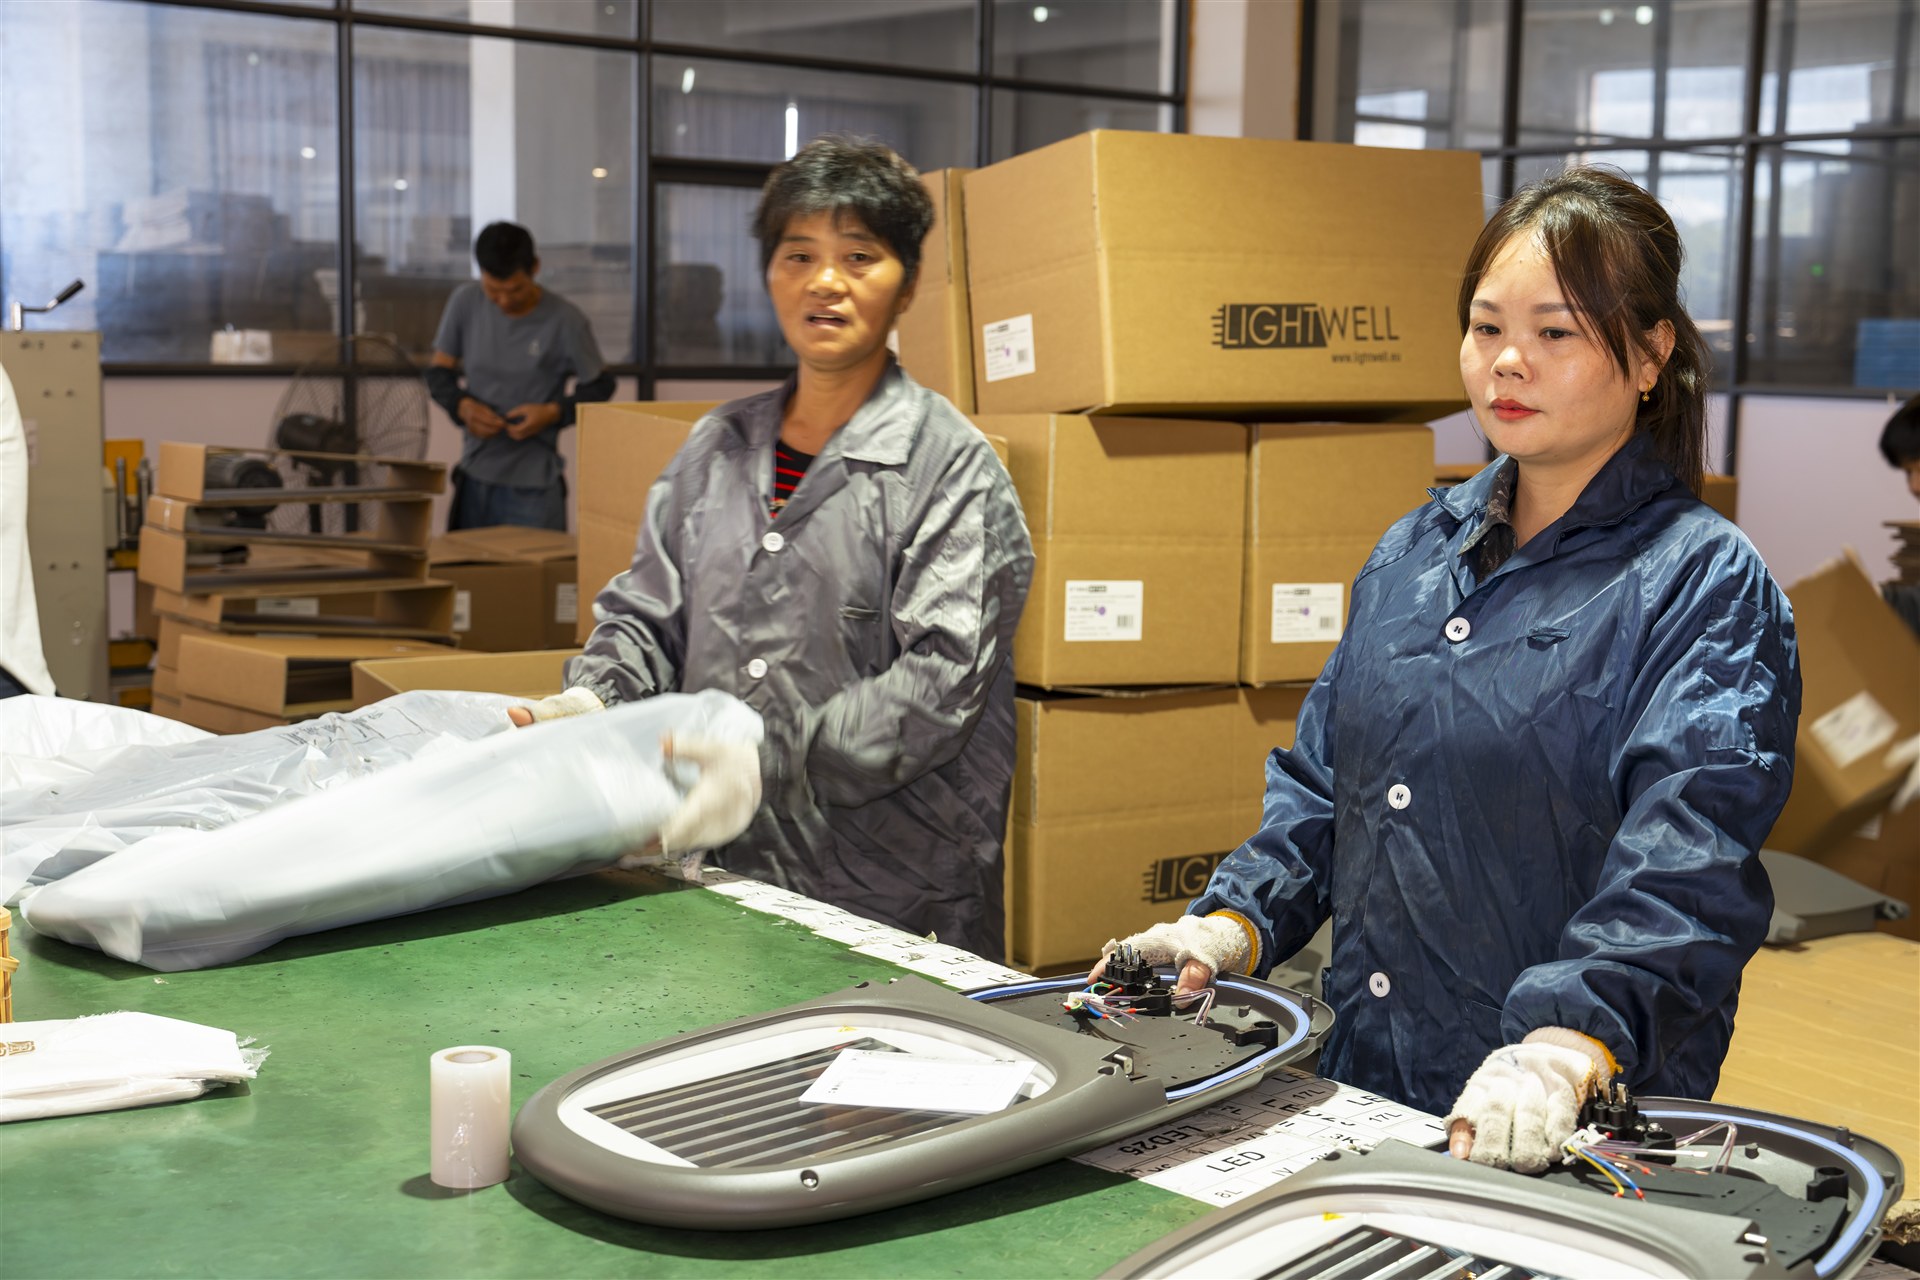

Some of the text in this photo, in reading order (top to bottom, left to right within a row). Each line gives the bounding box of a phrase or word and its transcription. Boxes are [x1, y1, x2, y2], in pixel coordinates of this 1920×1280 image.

[1222, 304, 1400, 348] LIGHTWELL
[1153, 853, 1219, 900] LIG
[1292, 1088, 1326, 1100] 17L
[1368, 1111, 1403, 1123] 17L
[1118, 1125, 1204, 1156] LED25
[1206, 1151, 1266, 1173] LED
